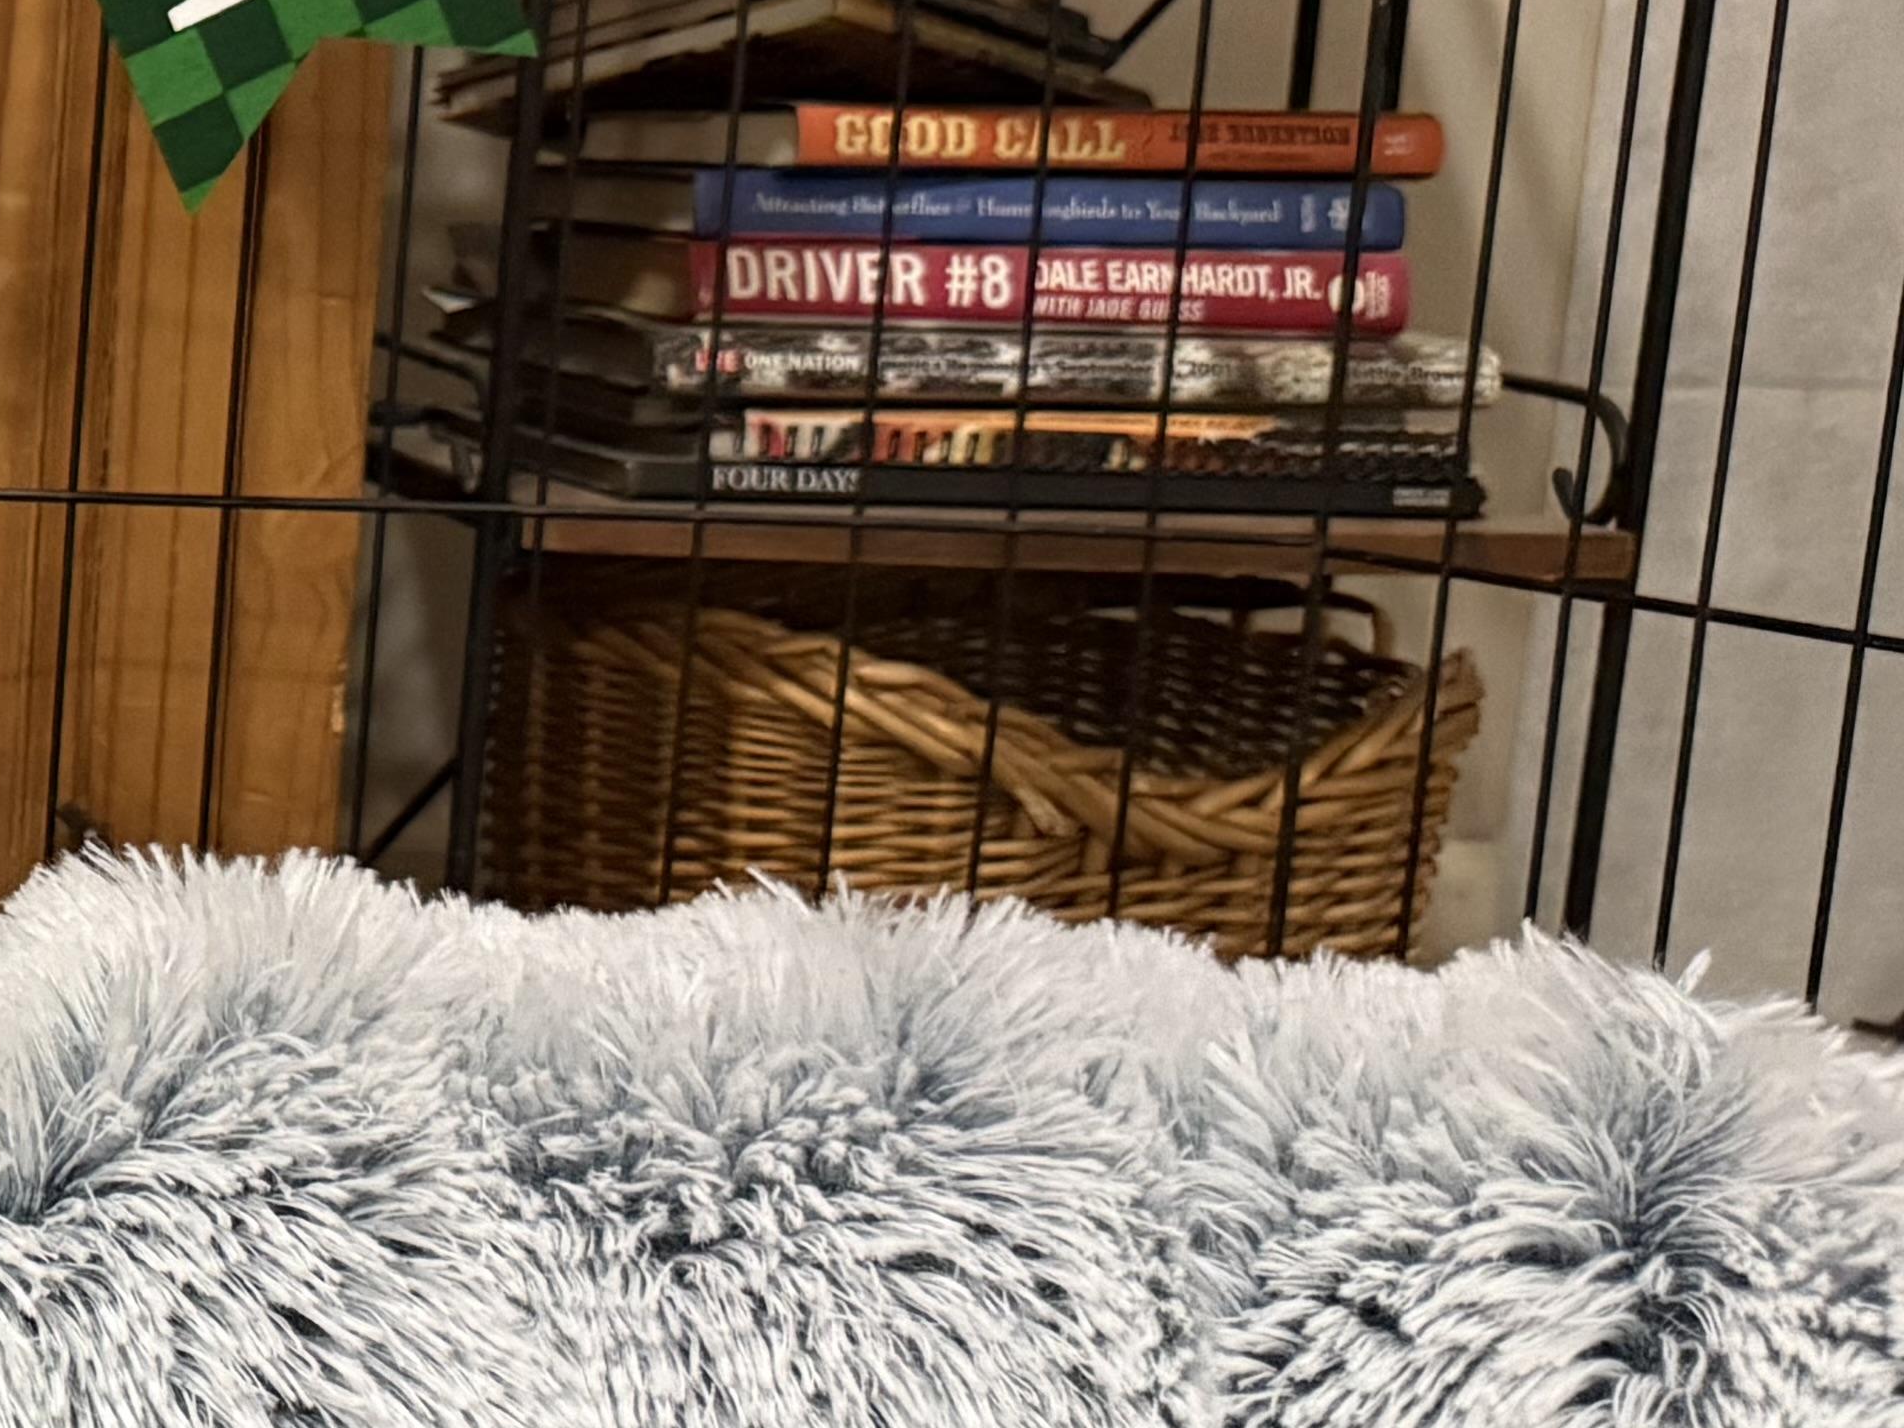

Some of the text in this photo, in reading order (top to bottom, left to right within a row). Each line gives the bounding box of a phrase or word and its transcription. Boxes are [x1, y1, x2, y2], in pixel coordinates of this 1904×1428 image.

[835, 114, 976, 158] GOOD
[726, 249, 1012, 310] DRIVER #8
[1280, 266, 1323, 300] JR.
[712, 466, 789, 492] FOUR
